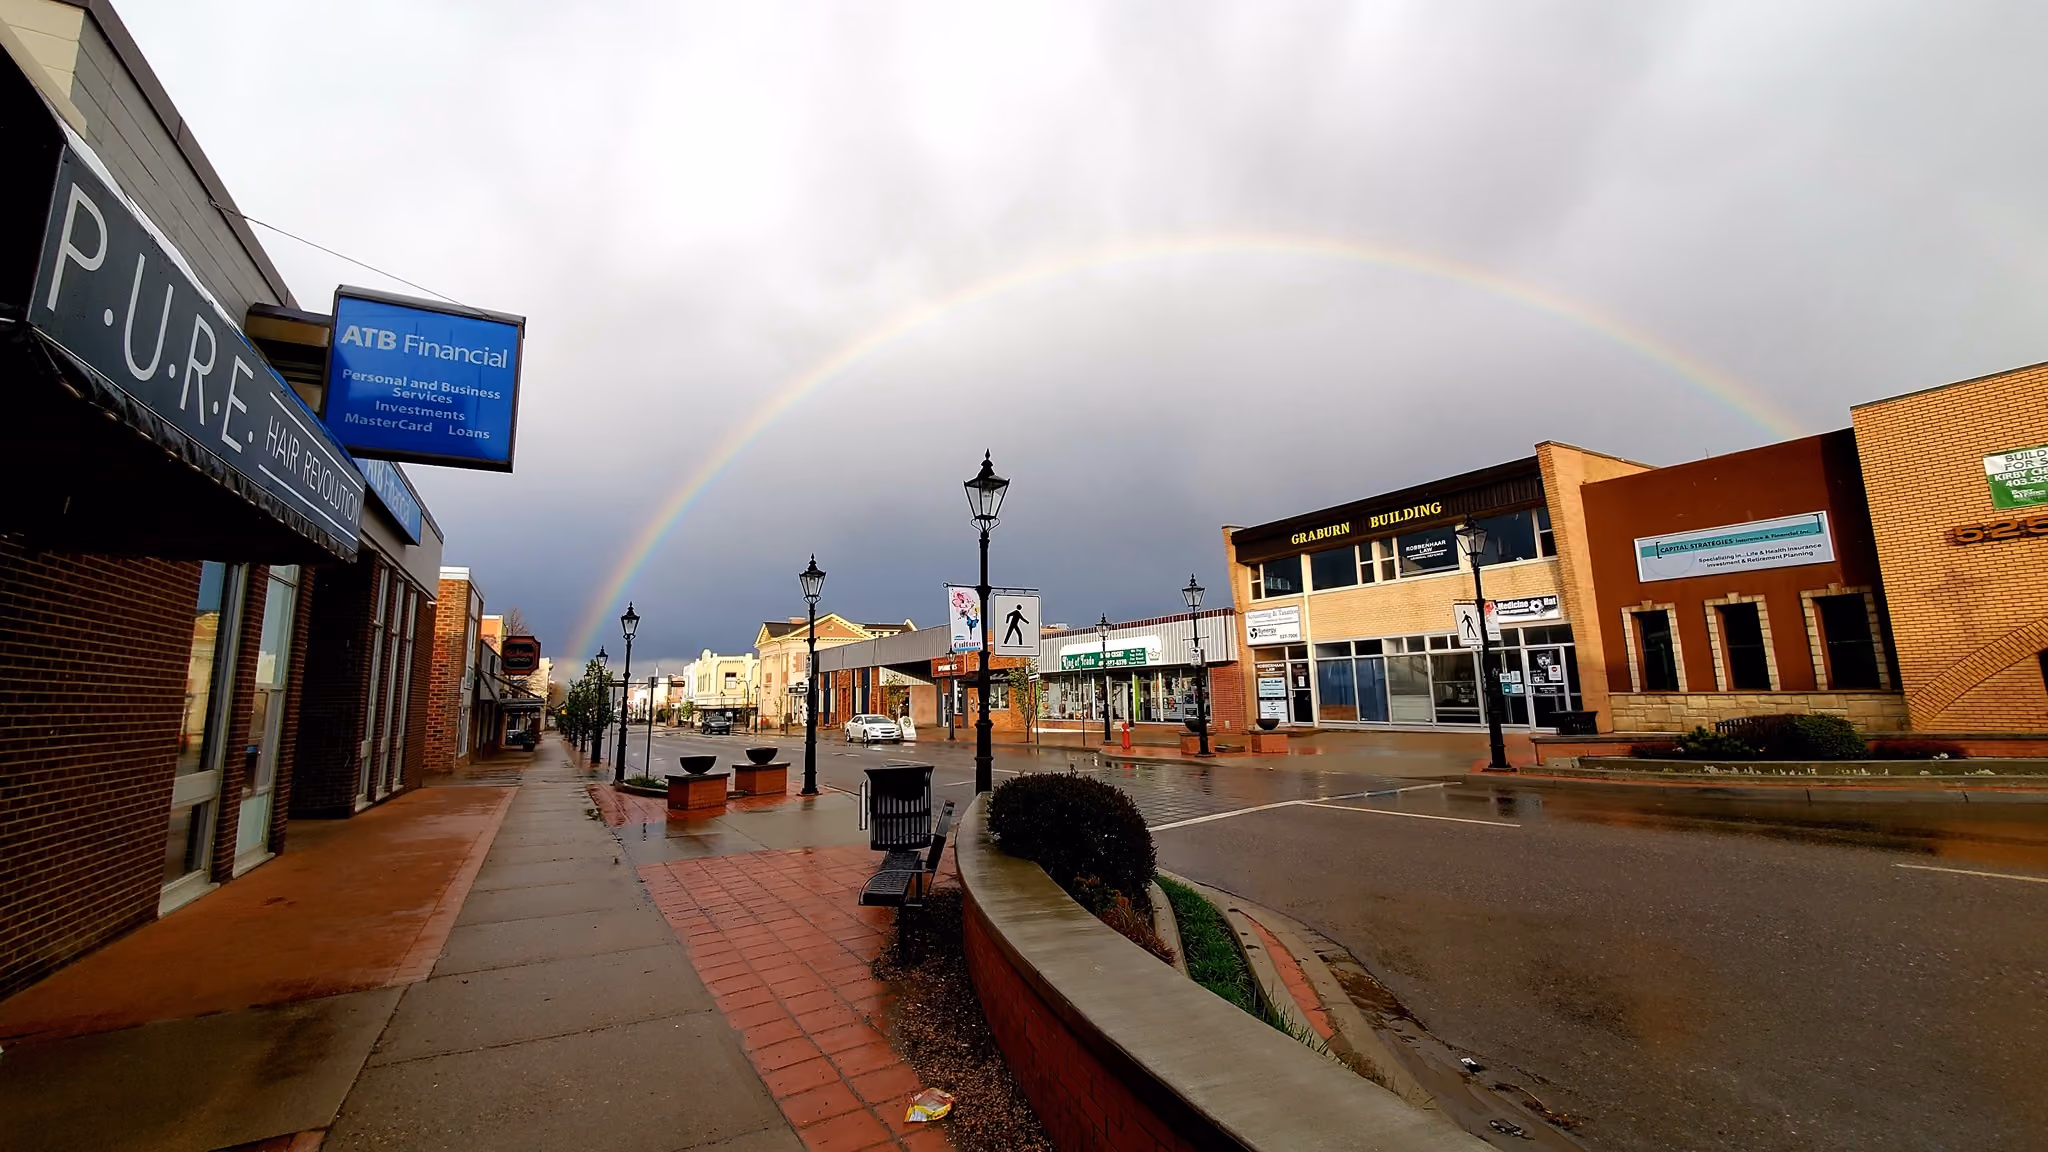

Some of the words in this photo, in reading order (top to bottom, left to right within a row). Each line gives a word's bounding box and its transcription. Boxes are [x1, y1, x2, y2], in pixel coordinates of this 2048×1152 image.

[47, 182, 254, 454] P.U.R.E.
[341, 325, 397, 350] ATB
[403, 334, 508, 369] Financial
[342, 369, 407, 387] Personal
[410, 378, 438, 391] and
[441, 382, 501, 400] Business
[392, 387, 453, 404] Services
[375, 400, 466, 421] Investments
[344, 412, 433, 433] MasterCard
[448, 424, 490, 439] Loans
[265, 415, 300, 475] HAIR
[302, 450, 361, 526] REVOLUTION
[2005, 460, 2035, 471] FOR
[1994, 470, 2027, 482] KIRBY
[1291, 522, 1350, 544] GRABURN
[1370, 502, 1442, 528] BUILDING
[1406, 540, 1446, 552] ROBBENHAAR
[1660, 545, 1688, 554] CAPITAL
[1690, 538, 1733, 550] STRATEGIES
[1698, 554, 1735, 563] Specializing
[1765, 547, 1786, 555] Health
[1787, 543, 1822, 552] Insurance
[1707, 559, 1740, 568] Investment
[1747, 554, 1782, 563] Retirement
[1783, 550, 1814, 559] Planning
[1497, 600, 1529, 609] Medicine
[1543, 597, 1556, 606] Hat
[953, 641, 981, 649] Culture
[1062, 656, 1074, 670] King
[1074, 656, 1080, 666] of
[1080, 653, 1095, 666] Trade
